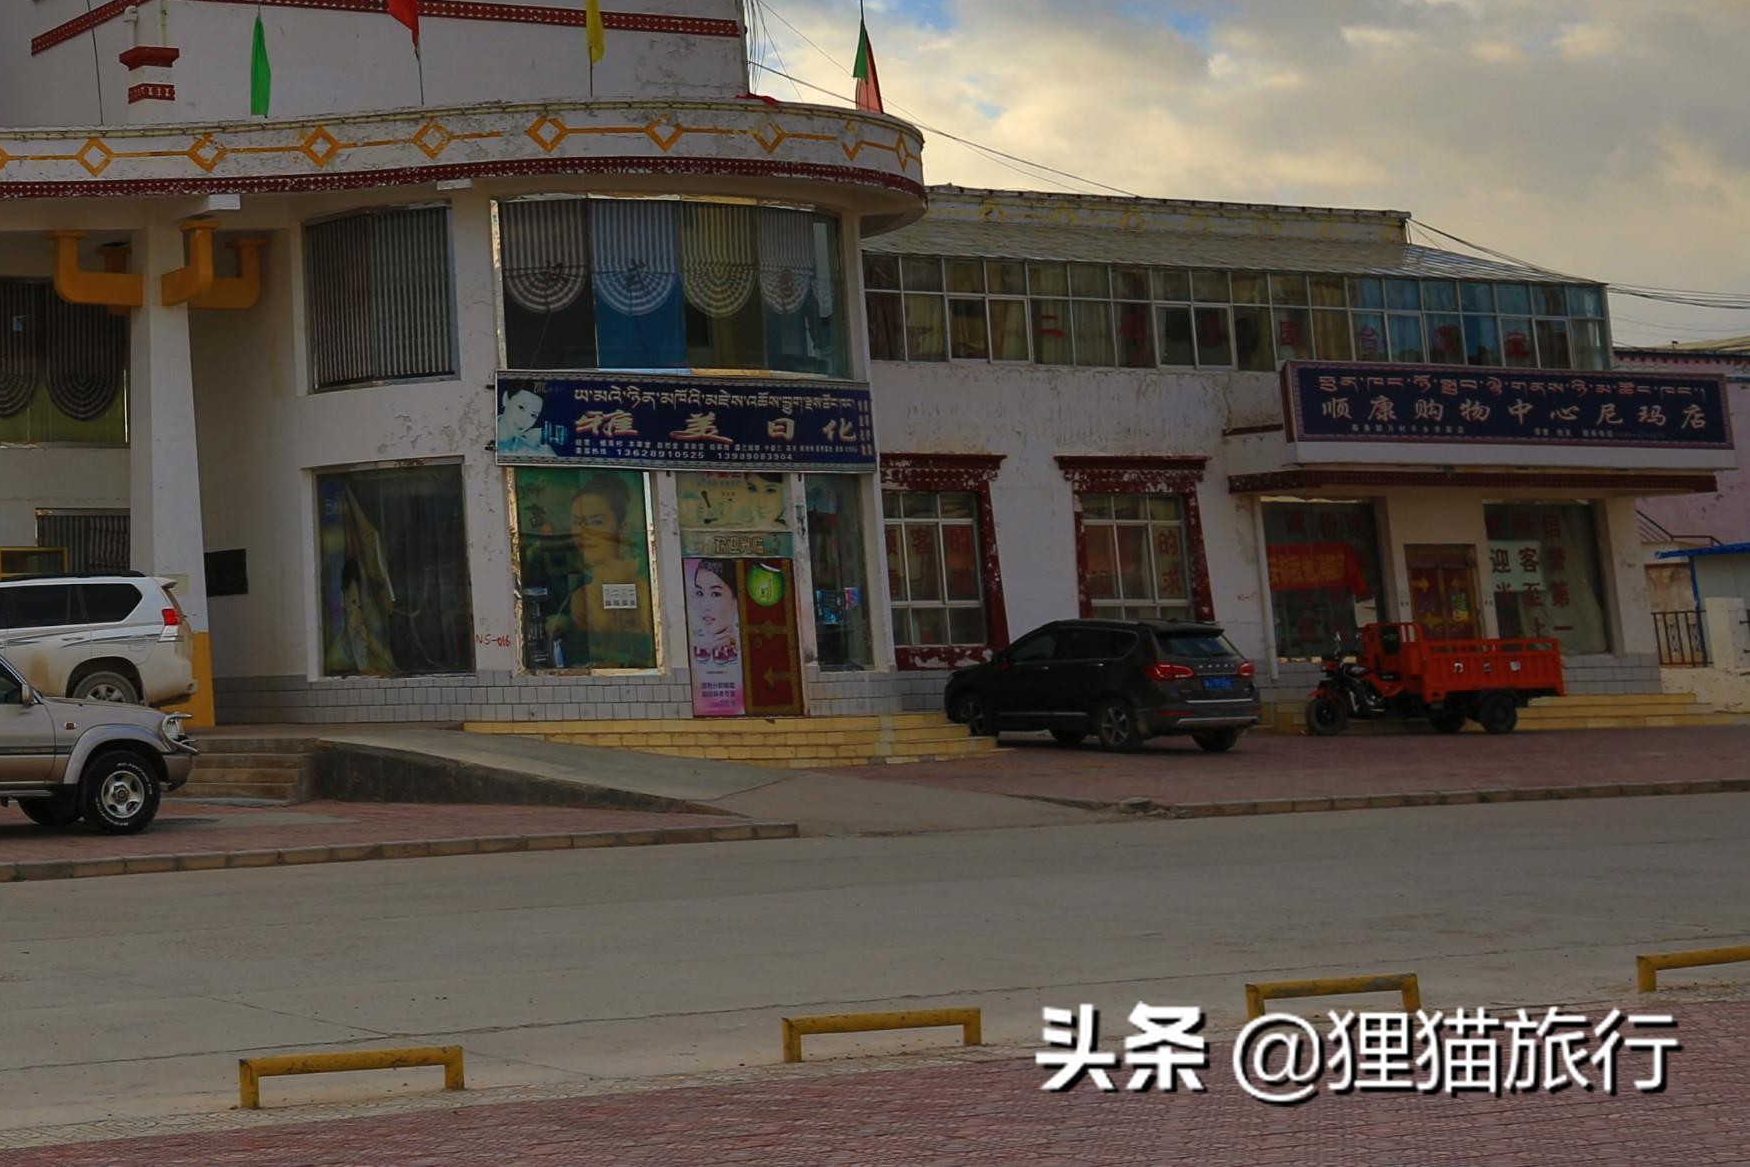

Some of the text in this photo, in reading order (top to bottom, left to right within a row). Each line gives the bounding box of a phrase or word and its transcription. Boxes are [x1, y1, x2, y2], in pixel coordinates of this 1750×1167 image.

[574, 409, 858, 444] 雅美日化
[1322, 395, 1708, 430] 顺康购物中心尼玛店
